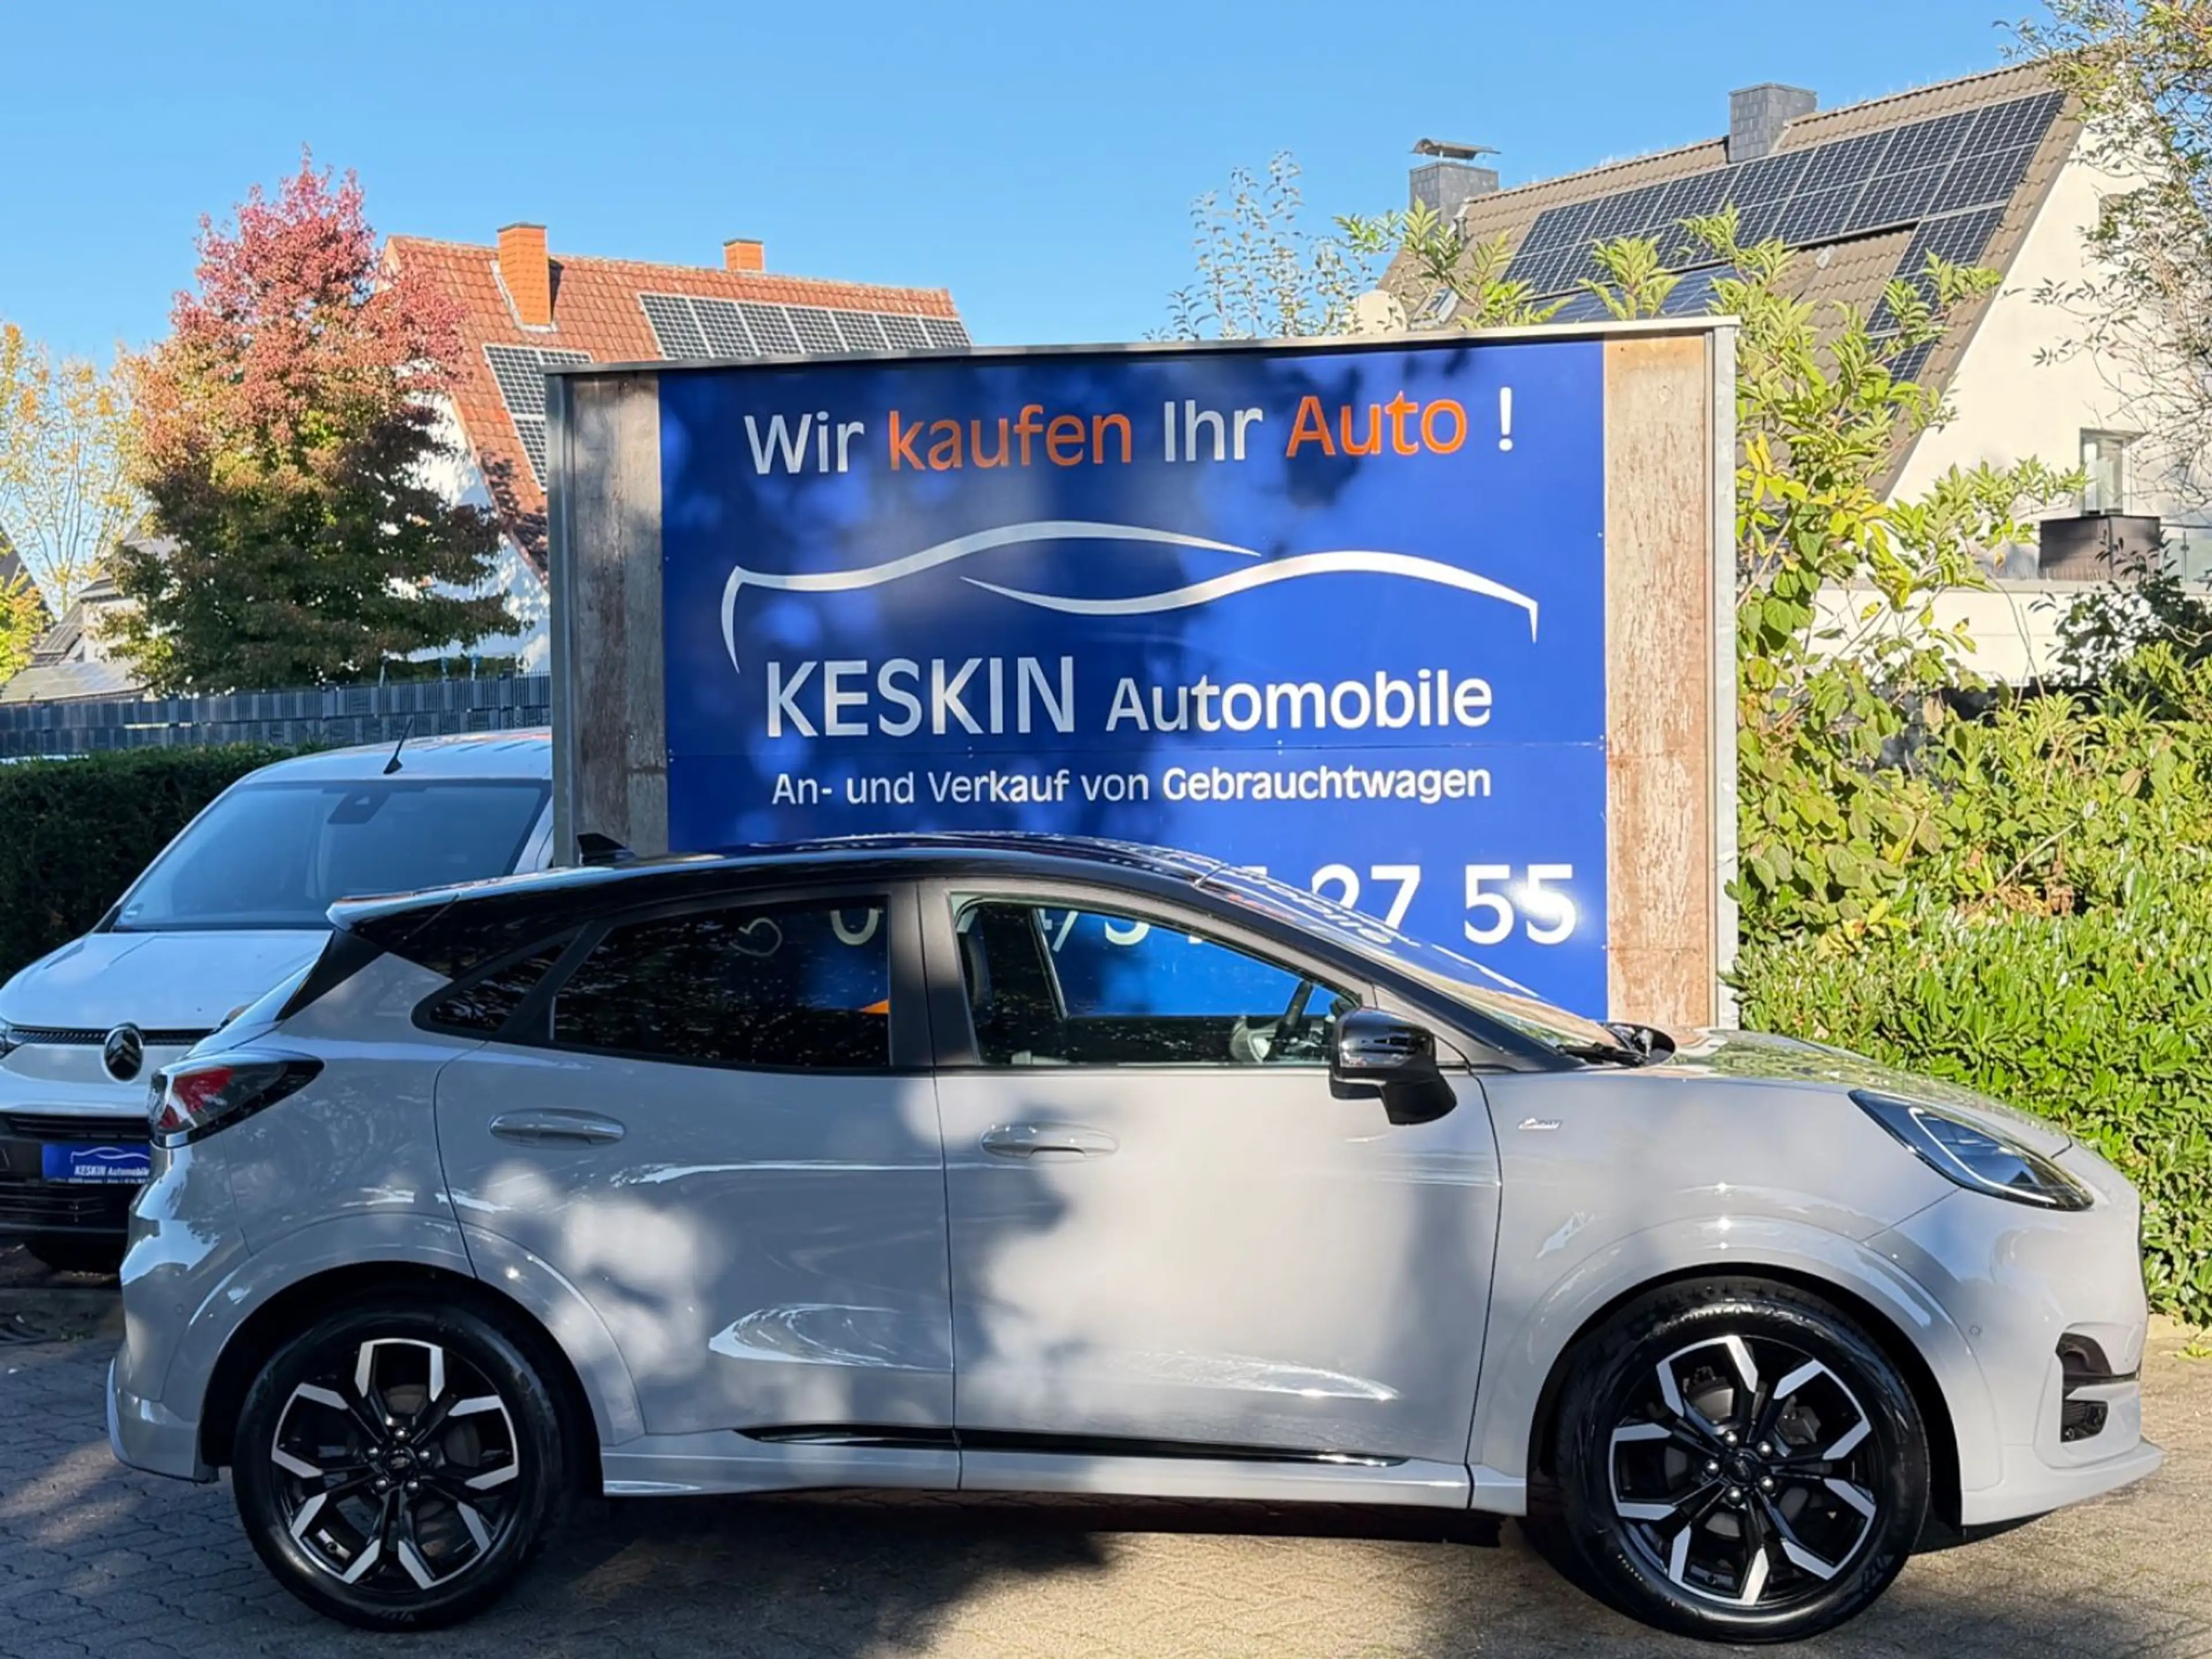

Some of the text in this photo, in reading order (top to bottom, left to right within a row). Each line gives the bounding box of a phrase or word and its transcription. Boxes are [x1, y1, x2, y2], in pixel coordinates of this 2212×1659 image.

[744, 386, 1514, 474] Wir kaufen Ihr Auto !
[767, 656, 1493, 737] KESKIN Automobile
[772, 765, 1492, 804] An- und Verkauf von Gebrauchtwagen
[1464, 863, 1577, 945] 55
[74, 1165, 106, 1176] KESKIN
